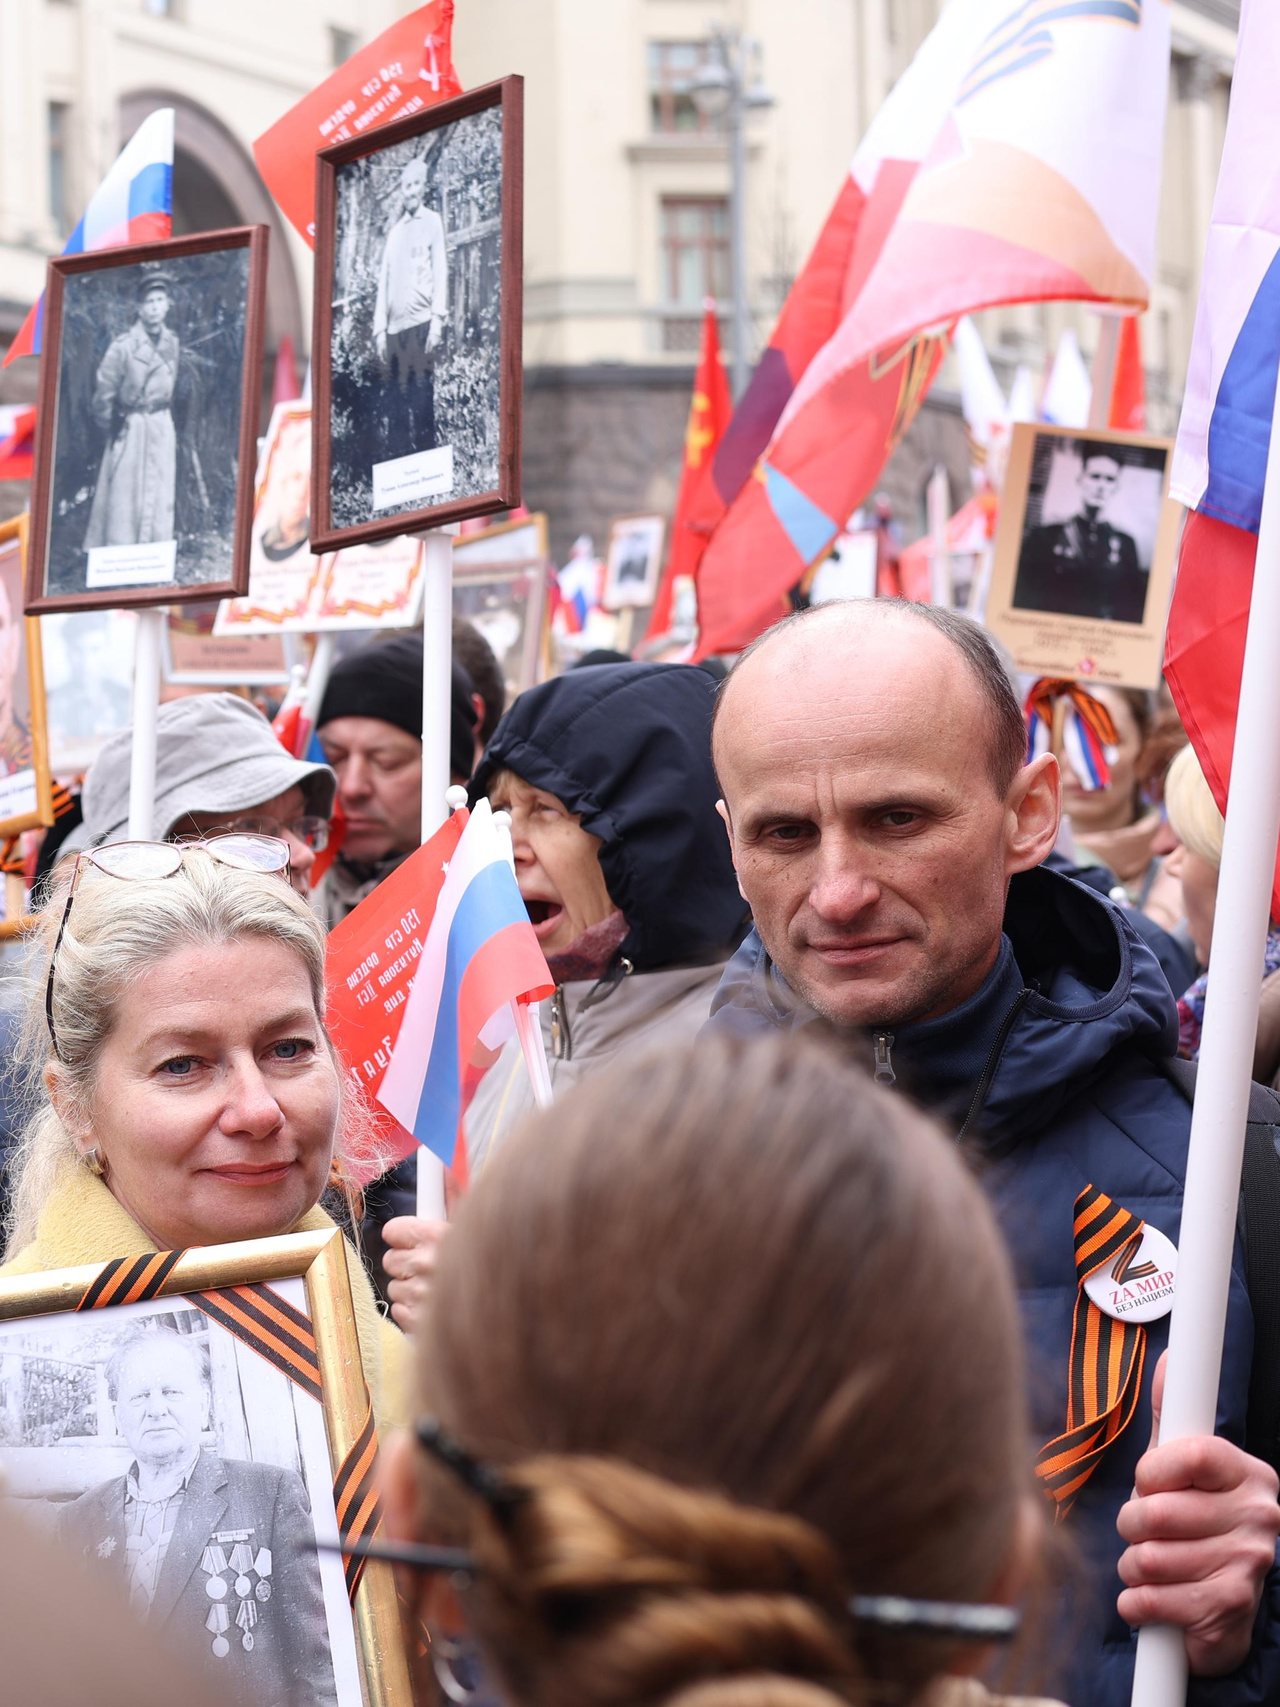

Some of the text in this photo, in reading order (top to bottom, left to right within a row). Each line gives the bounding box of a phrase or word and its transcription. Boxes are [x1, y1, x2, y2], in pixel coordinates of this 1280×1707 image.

[1109, 1271, 1174, 1305] ZA МИР
[1115, 1286, 1176, 1314] БЕЗ НАЦИЗМ
